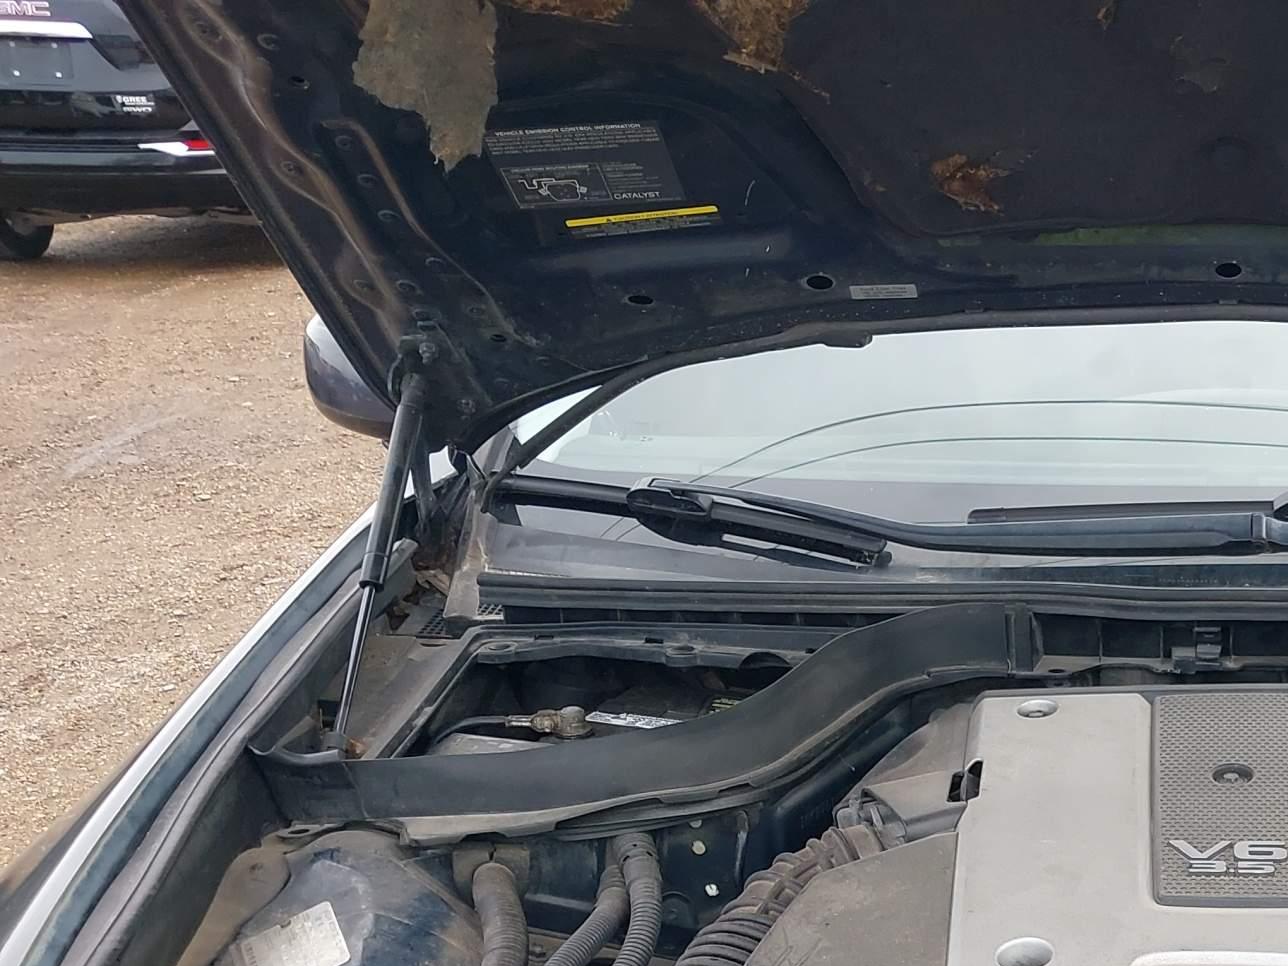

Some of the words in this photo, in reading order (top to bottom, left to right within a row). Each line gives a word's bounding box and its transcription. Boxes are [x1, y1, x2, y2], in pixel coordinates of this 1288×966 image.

[613, 191, 660, 200] CATALYST
[1168, 840, 1288, 861] V6
[1187, 860, 1276, 873] 3.5
